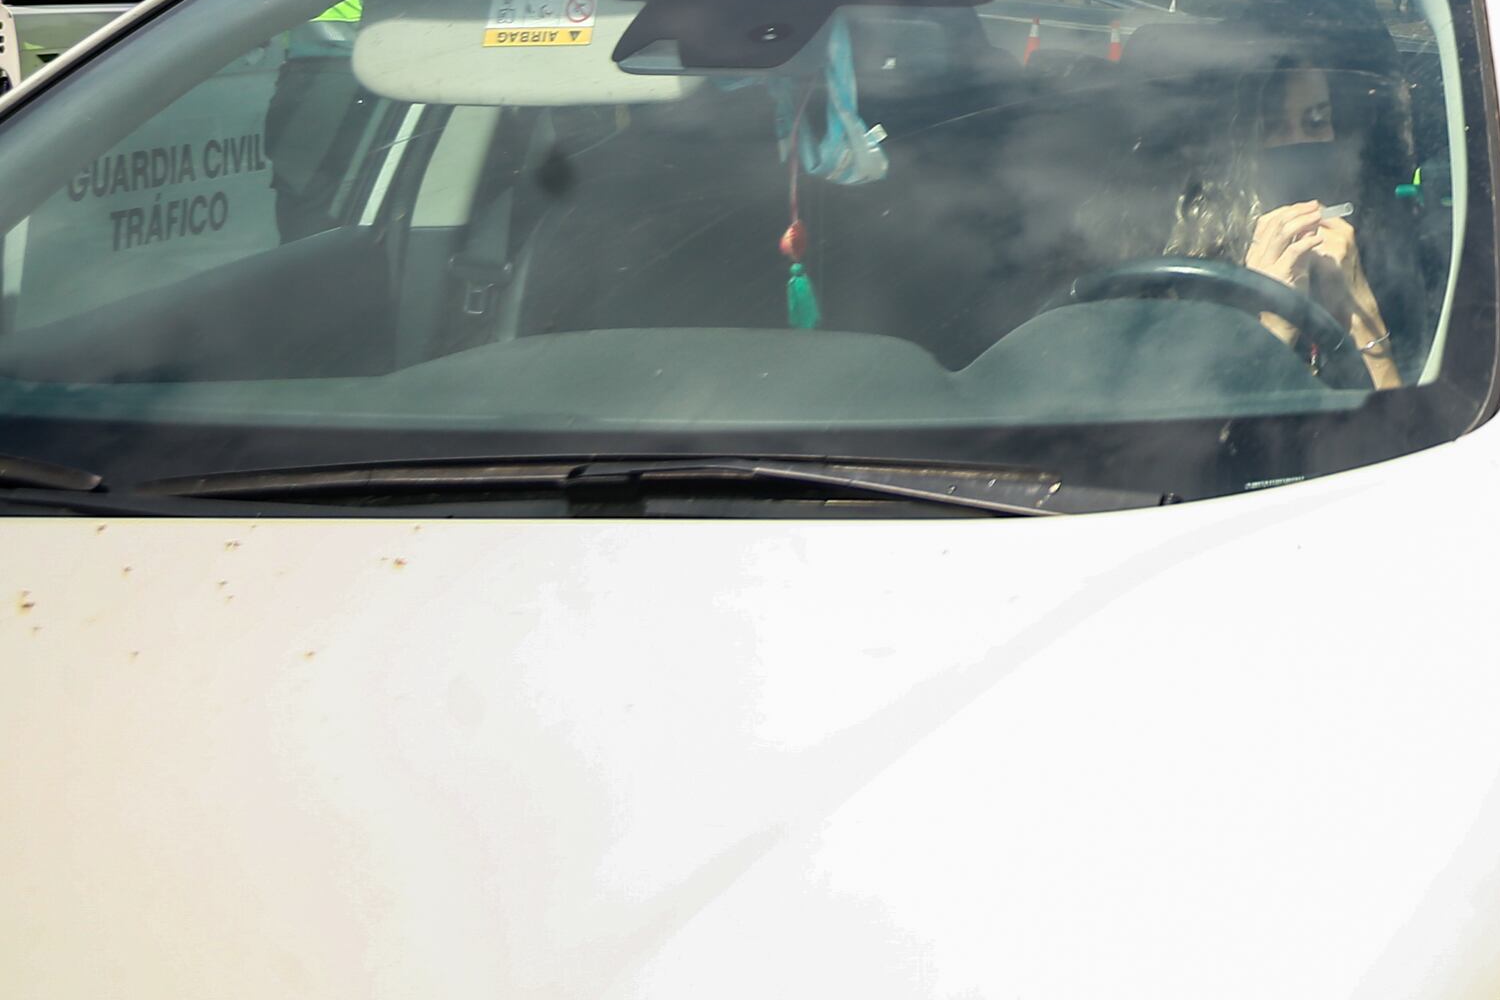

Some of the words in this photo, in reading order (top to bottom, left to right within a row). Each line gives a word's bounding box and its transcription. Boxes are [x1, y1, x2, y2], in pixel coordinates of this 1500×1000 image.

[497, 30, 560, 44] AIRBAG
[68, 143, 196, 202] GUARDIA
[203, 133, 266, 179] CIVIL
[109, 191, 229, 251] TRÁFICO
